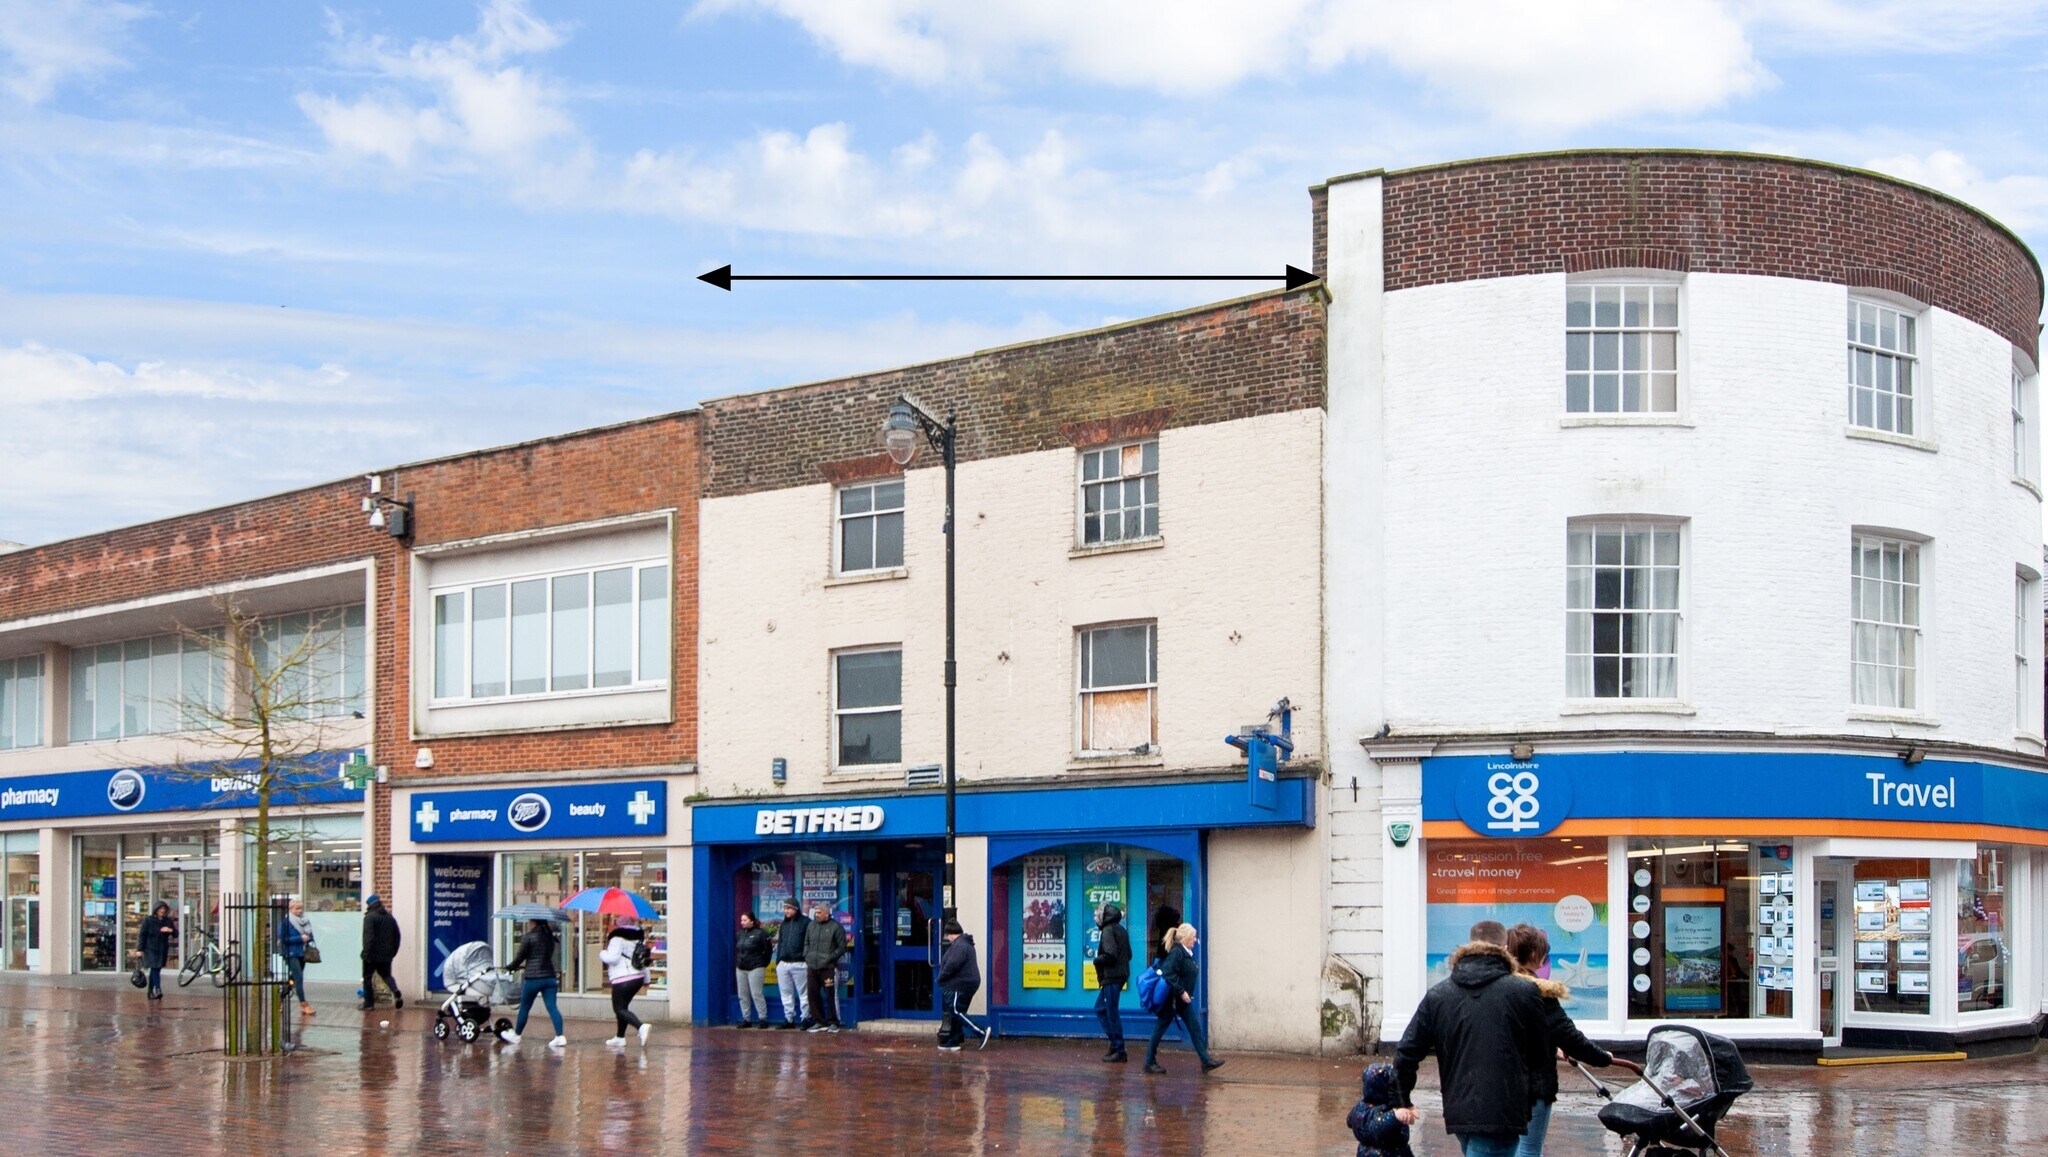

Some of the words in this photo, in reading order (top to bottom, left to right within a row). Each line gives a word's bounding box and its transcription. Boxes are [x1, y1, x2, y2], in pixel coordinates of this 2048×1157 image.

[1487, 762, 1540, 770] Lincolnshire
[1, 787, 59, 808] pharmacy
[111, 779, 136, 800] Boots
[211, 770, 262, 795] beauty
[1865, 772, 1955, 808] Travel
[449, 808, 498, 822] pharmacy
[513, 801, 541, 822] Boots
[569, 802, 606, 817] beauty
[755, 805, 885, 835] BETFRED
[1436, 851, 1513, 862] Commission
[1516, 851, 1543, 862] free
[434, 866, 481, 878] welcome
[1026, 865, 1063, 879] BEST
[1436, 867, 1475, 878] travel
[1478, 867, 1522, 879] money
[1026, 878, 1063, 891] ODDS
[1089, 890, 1121, 902] £750
[1436, 887, 1457, 895] Great
[1497, 887, 1516, 896] major
[434, 901, 469, 909] hearingcare
[434, 919, 452, 927] photo
